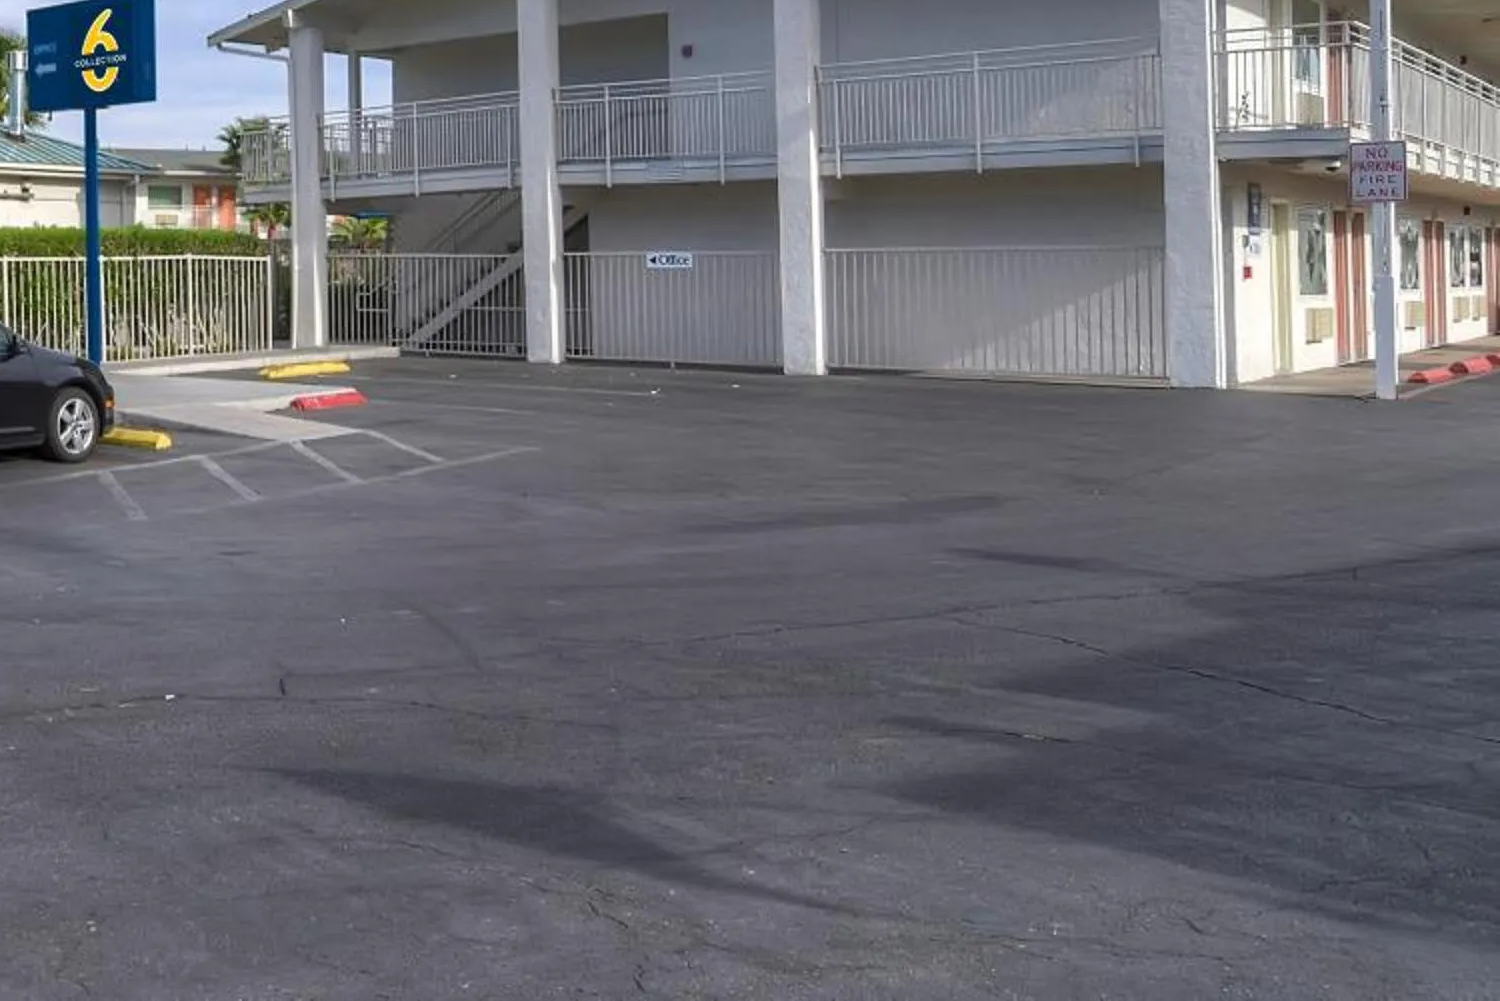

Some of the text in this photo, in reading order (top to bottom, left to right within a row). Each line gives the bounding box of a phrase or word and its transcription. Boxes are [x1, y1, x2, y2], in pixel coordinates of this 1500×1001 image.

[81, 8, 119, 92] 6
[74, 53, 127, 69] COLLECTION
[1365, 147, 1388, 159] NO
[1352, 160, 1402, 172] PARKING
[1358, 174, 1397, 184] FIRE
[1355, 187, 1400, 198] LANE
[658, 254, 690, 266] Office
